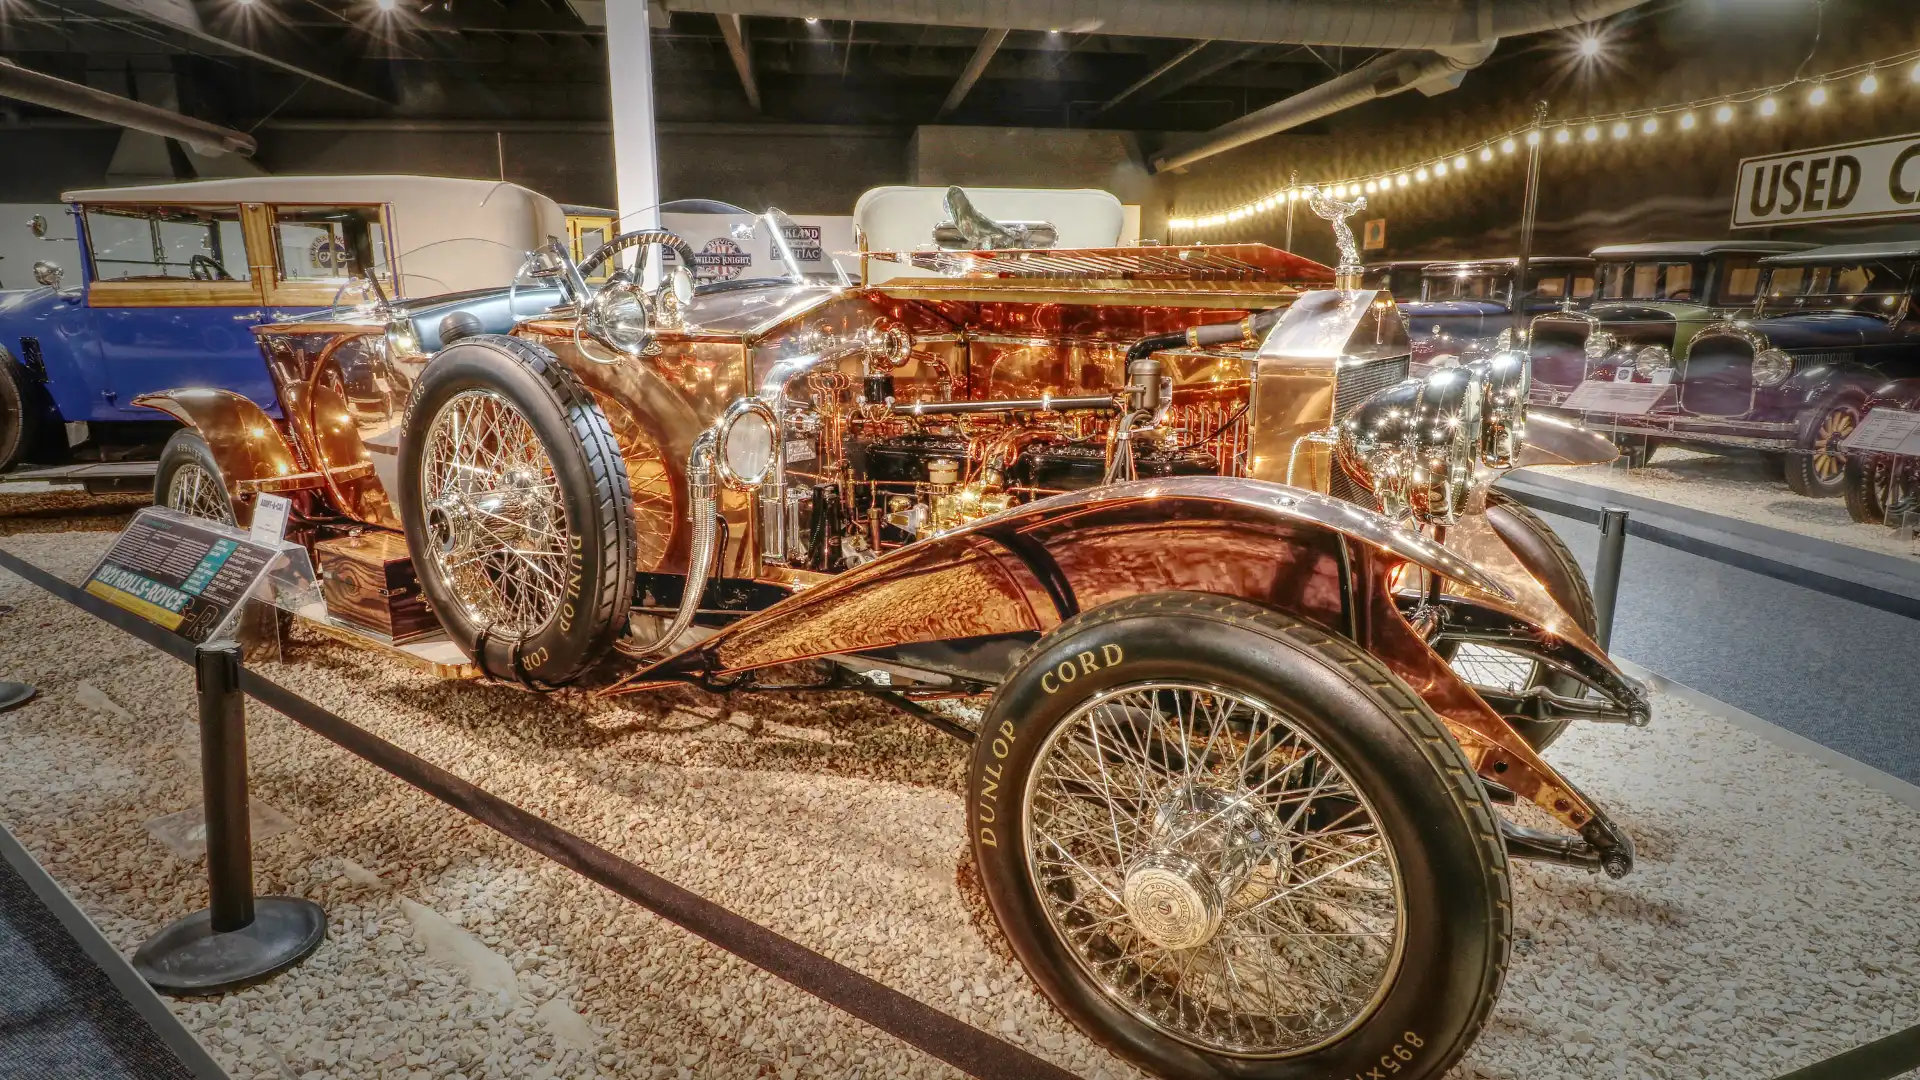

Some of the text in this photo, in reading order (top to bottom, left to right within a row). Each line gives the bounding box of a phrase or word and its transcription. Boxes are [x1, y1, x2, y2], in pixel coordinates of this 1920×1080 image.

[1750, 142, 1920, 217] USED C
[695, 256, 721, 264] WILLYS
[772, 247, 819, 259] PTIAC
[97, 564, 121, 583] 1921
[116, 571, 188, 609] ROLLS-ROYCE
[559, 533, 583, 632] DUNLOP
[521, 646, 549, 671] COR
[1041, 643, 1123, 694] CORD
[979, 719, 1017, 848] DUNLOP
